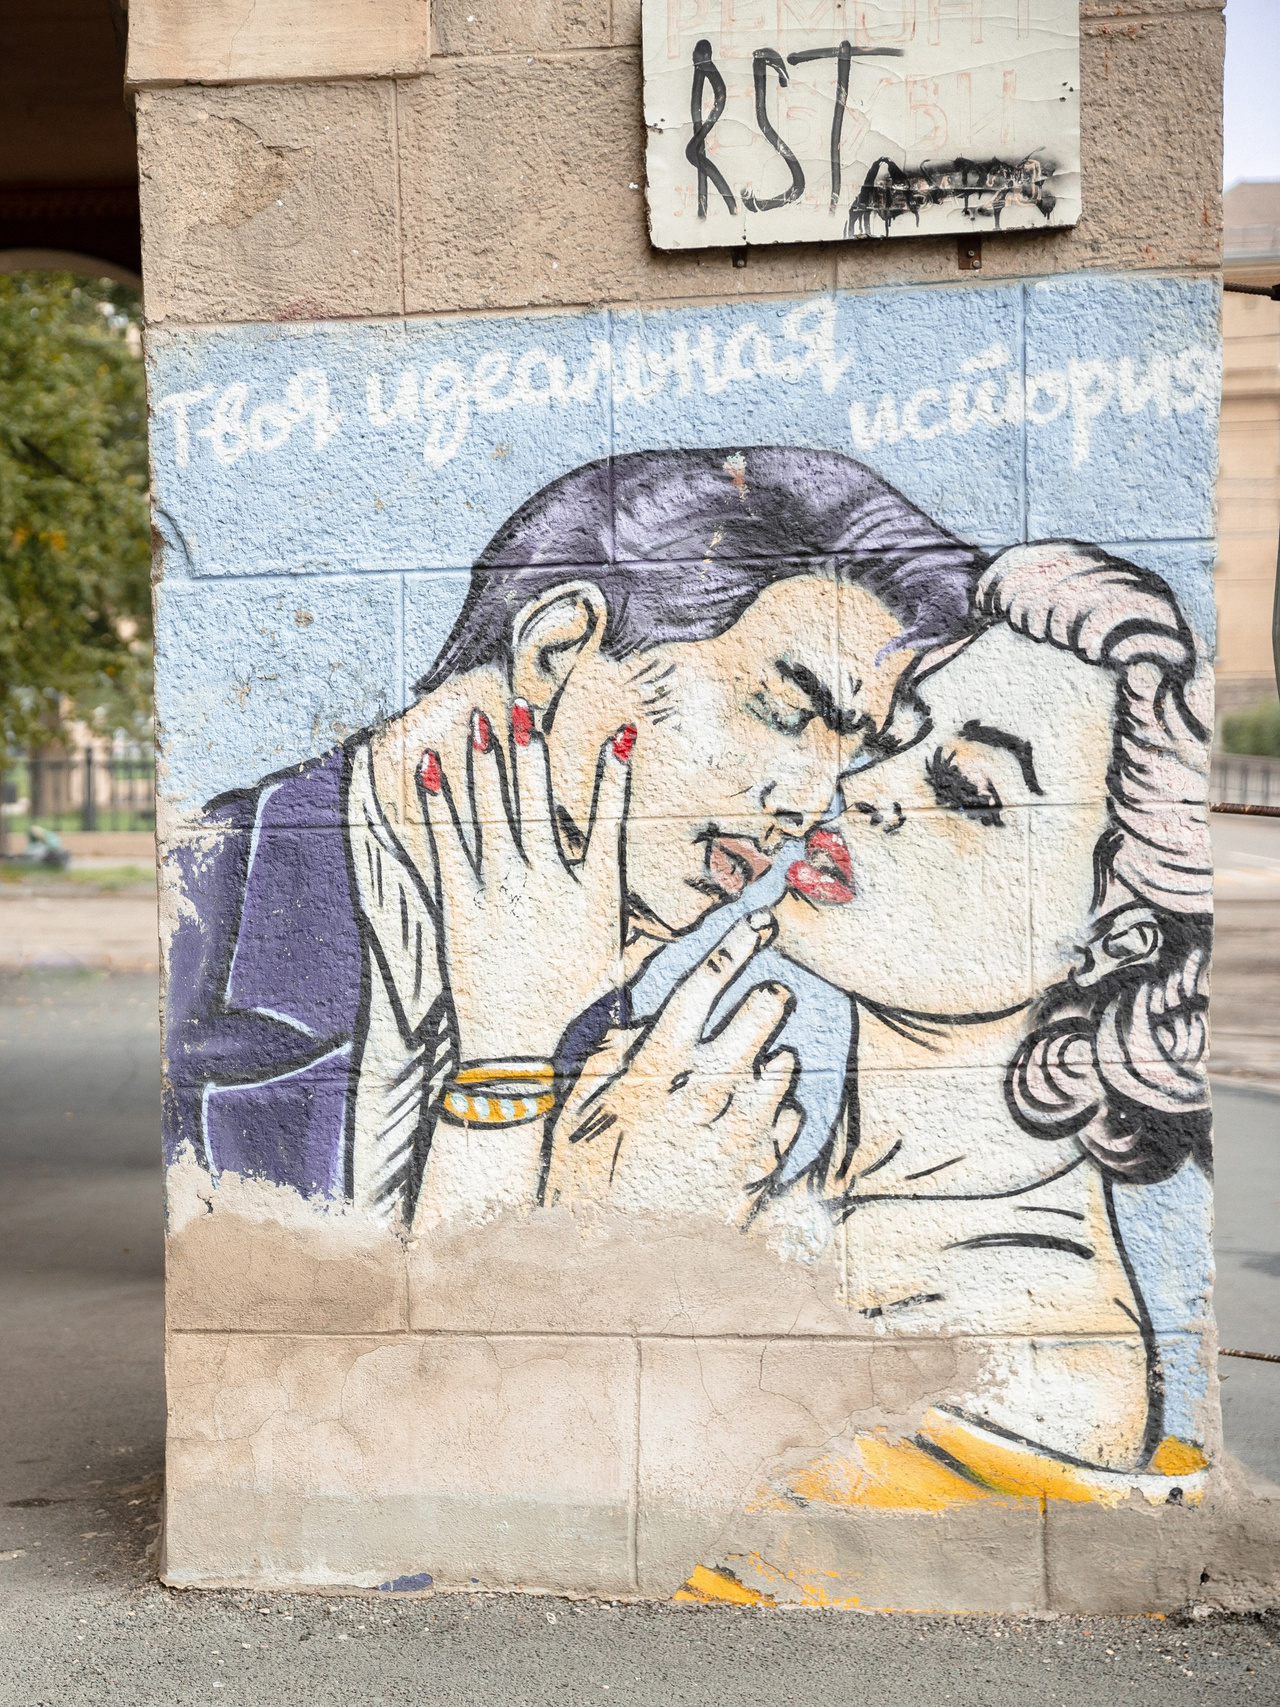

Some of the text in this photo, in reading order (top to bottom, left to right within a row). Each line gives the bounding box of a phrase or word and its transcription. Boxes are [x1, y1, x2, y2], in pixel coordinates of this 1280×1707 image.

[686, 39, 904, 219] RST
[365, 298, 853, 468] идеальная
[848, 344, 1220, 466] история
